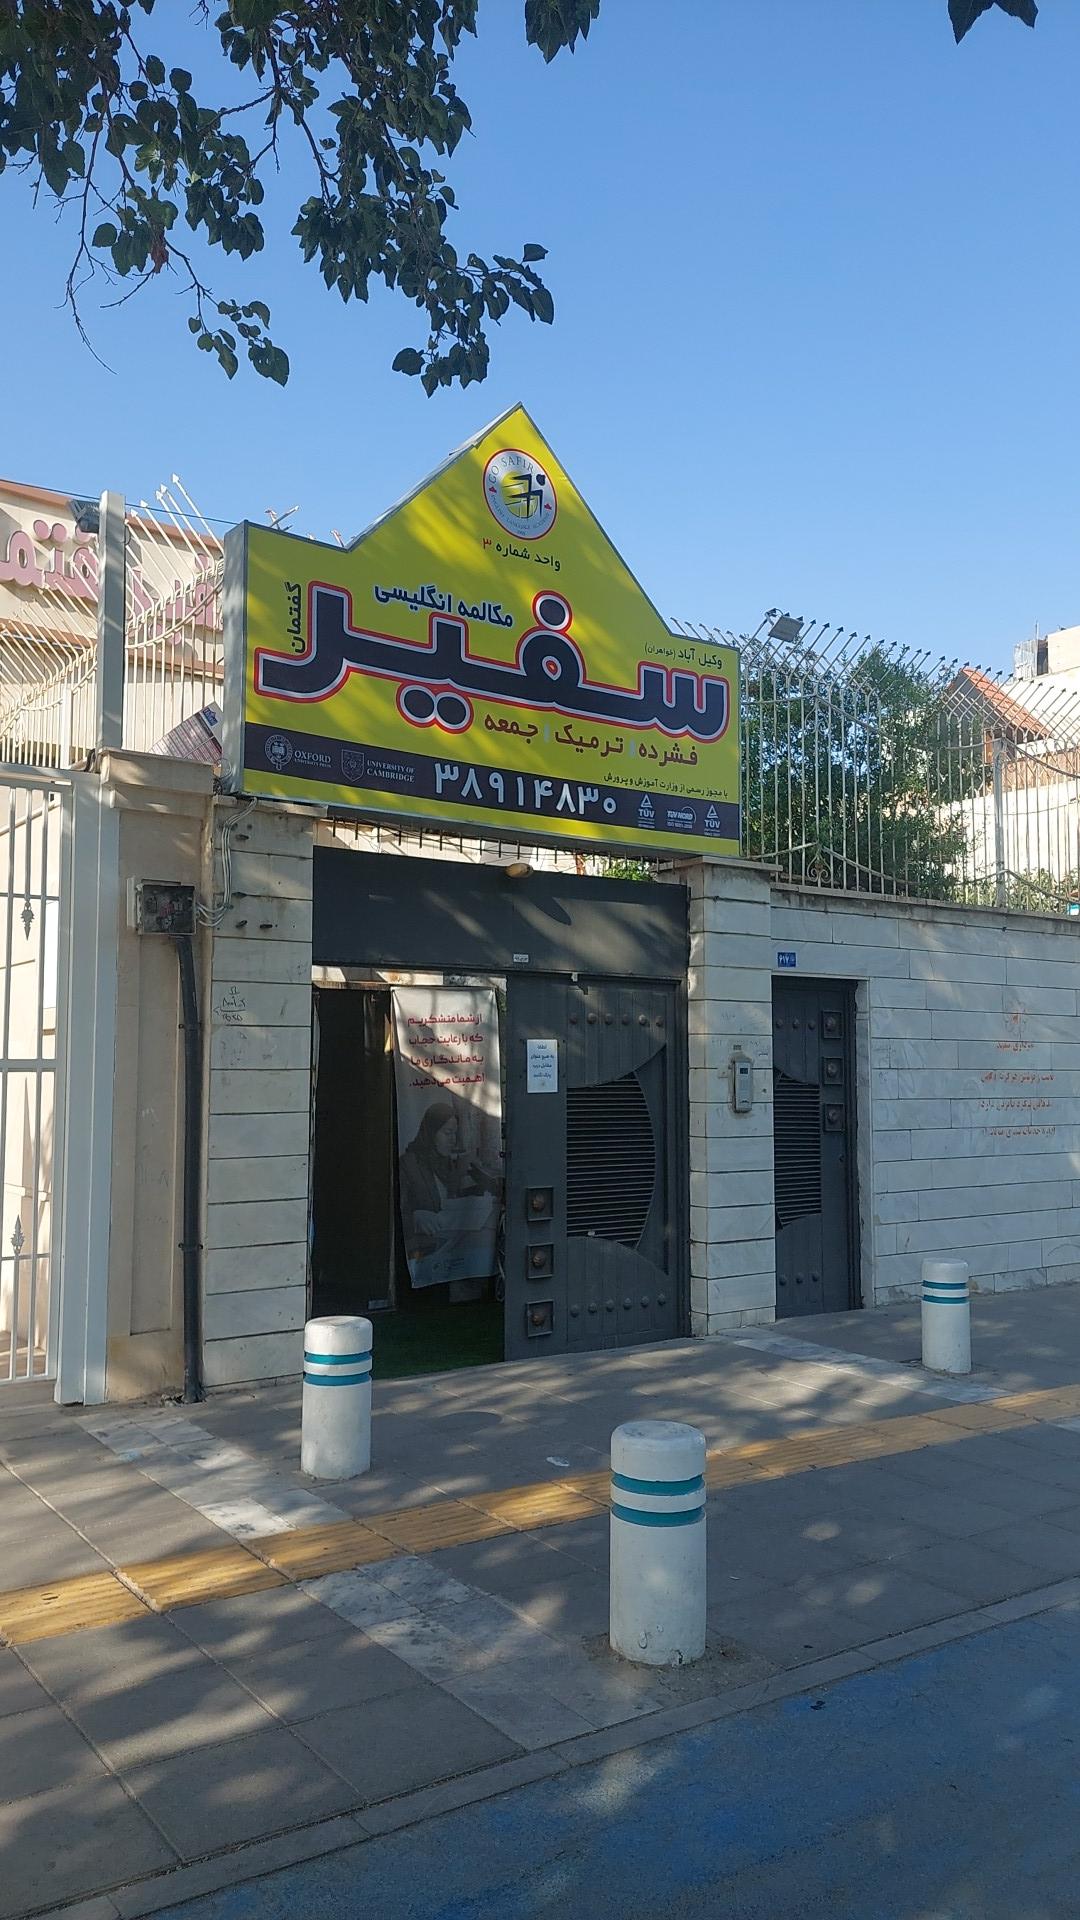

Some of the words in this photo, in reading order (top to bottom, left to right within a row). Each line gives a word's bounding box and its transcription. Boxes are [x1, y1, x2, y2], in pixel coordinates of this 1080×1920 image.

[488, 465, 500, 484] GO
[501, 456, 535, 473] SAFIR
[482, 538, 492, 549] ۳
[496, 542, 530, 560] شماره
[534, 553, 561, 571] واحد
[374, 584, 453, 613] انگلیسی
[284, 581, 306, 653] گفتمان
[457, 600, 514, 628] مکالمه
[254, 580, 730, 744] سفیر
[677, 648, 696, 663] آباد
[698, 653, 723, 669] وکیل
[484, 714, 539, 745] جمعه
[294, 751, 331, 764] OXFORD
[638, 742, 699, 767] فشرده
[367, 760, 404, 773] UNIVERSITY
[367, 769, 415, 783] CAMBRIDGE
[634, 777, 658, 788] آموزش
[660, 782, 678, 792] وزارت
[704, 819, 720, 828] TÜV
[407, 1013, 457, 1027] متشکریم
[409, 1035, 436, 1048] حجاب
[437, 1034, 461, 1047] رعایت
[469, 1032, 484, 1042] که
[472, 1054, 484, 1064] به
[452, 1073, 485, 1086] اهمیت
